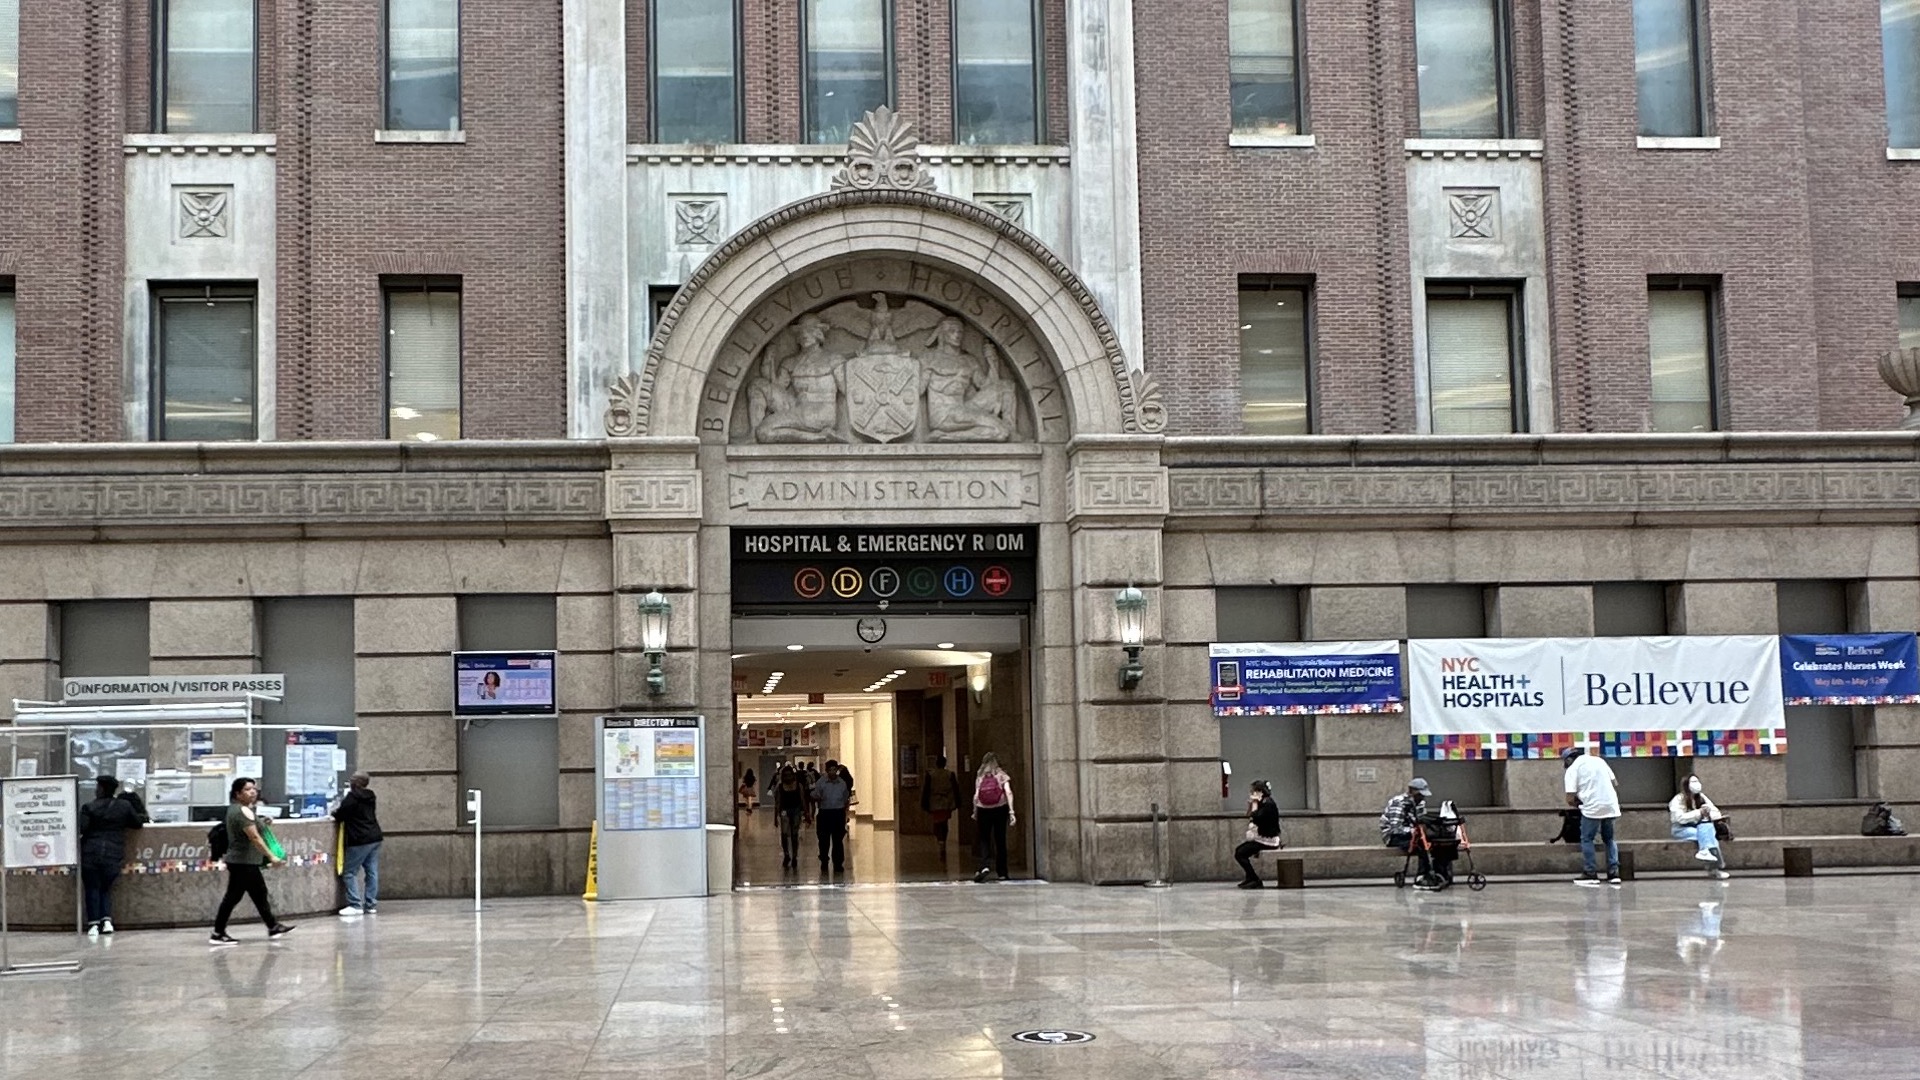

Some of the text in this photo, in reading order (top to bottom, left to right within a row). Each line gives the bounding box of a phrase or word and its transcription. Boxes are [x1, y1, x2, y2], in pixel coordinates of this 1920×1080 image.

[702, 264, 1063, 432] BELLEVUE HOSPITAL
[762, 480, 1009, 500] ADMINISTRATION
[744, 535, 832, 552] HOSPITAL
[837, 534, 852, 552] &
[858, 534, 966, 552] EMERGENCY
[1245, 668, 1336, 679] REHABILITATION
[1339, 666, 1394, 678] MEDICINE
[1441, 657, 1480, 672] NYC
[1792, 659, 1906, 671] Celebrates Nurses Week
[80, 682, 169, 694] INFORMATION
[232, 680, 282, 692] PASSES
[1583, 672, 1750, 706] Bellevue
[1443, 691, 1544, 708] HOSPITALS
[633, 718, 675, 727] DIRECTORY
